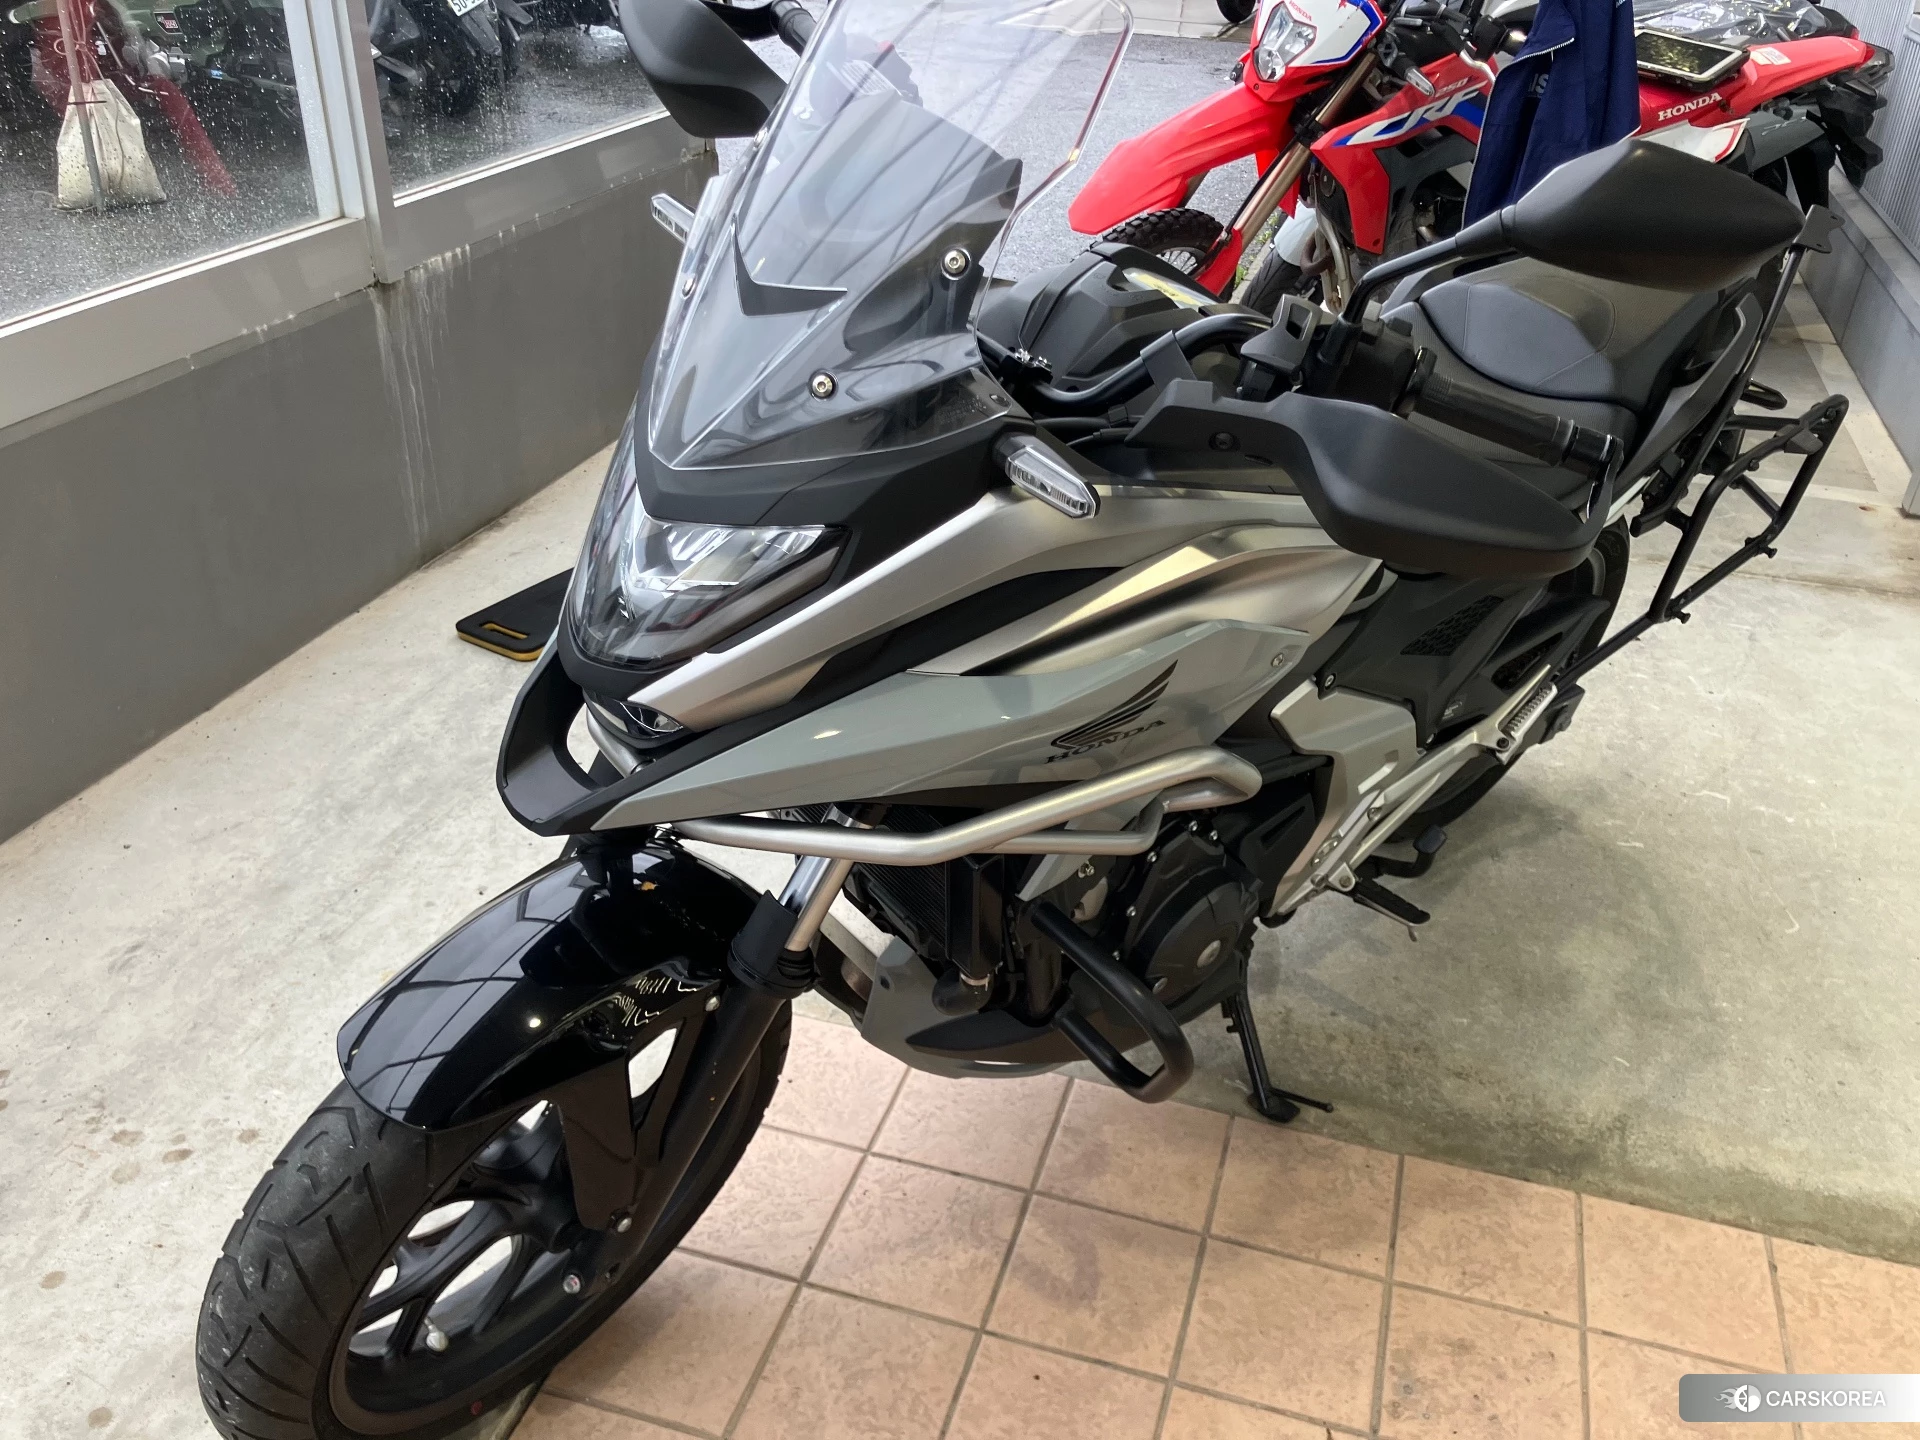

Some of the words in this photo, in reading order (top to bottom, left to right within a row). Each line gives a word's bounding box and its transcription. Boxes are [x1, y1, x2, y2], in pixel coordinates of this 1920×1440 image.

[1288, 0, 1313, 21] HONDA
[1345, 79, 1489, 146] CRF
[1657, 92, 1723, 122] HONDA
[1044, 719, 1166, 765] HONDA
